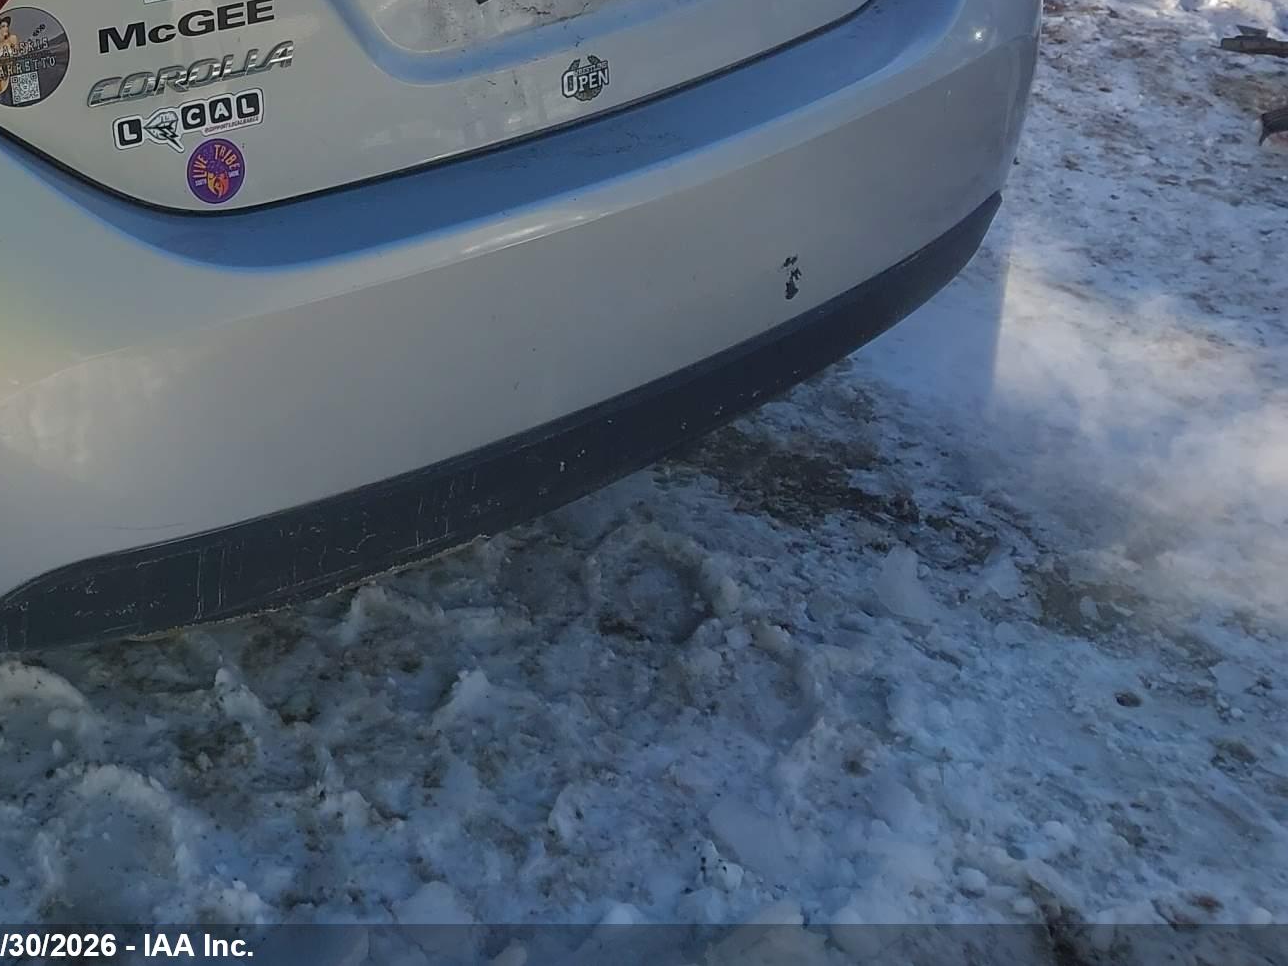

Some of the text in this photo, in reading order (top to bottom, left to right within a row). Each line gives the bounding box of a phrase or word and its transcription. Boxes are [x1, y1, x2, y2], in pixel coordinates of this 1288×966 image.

[87, 40, 294, 107] COROLLA
[563, 69, 609, 97] OPEN
[214, 144, 240, 170] TRIBE
